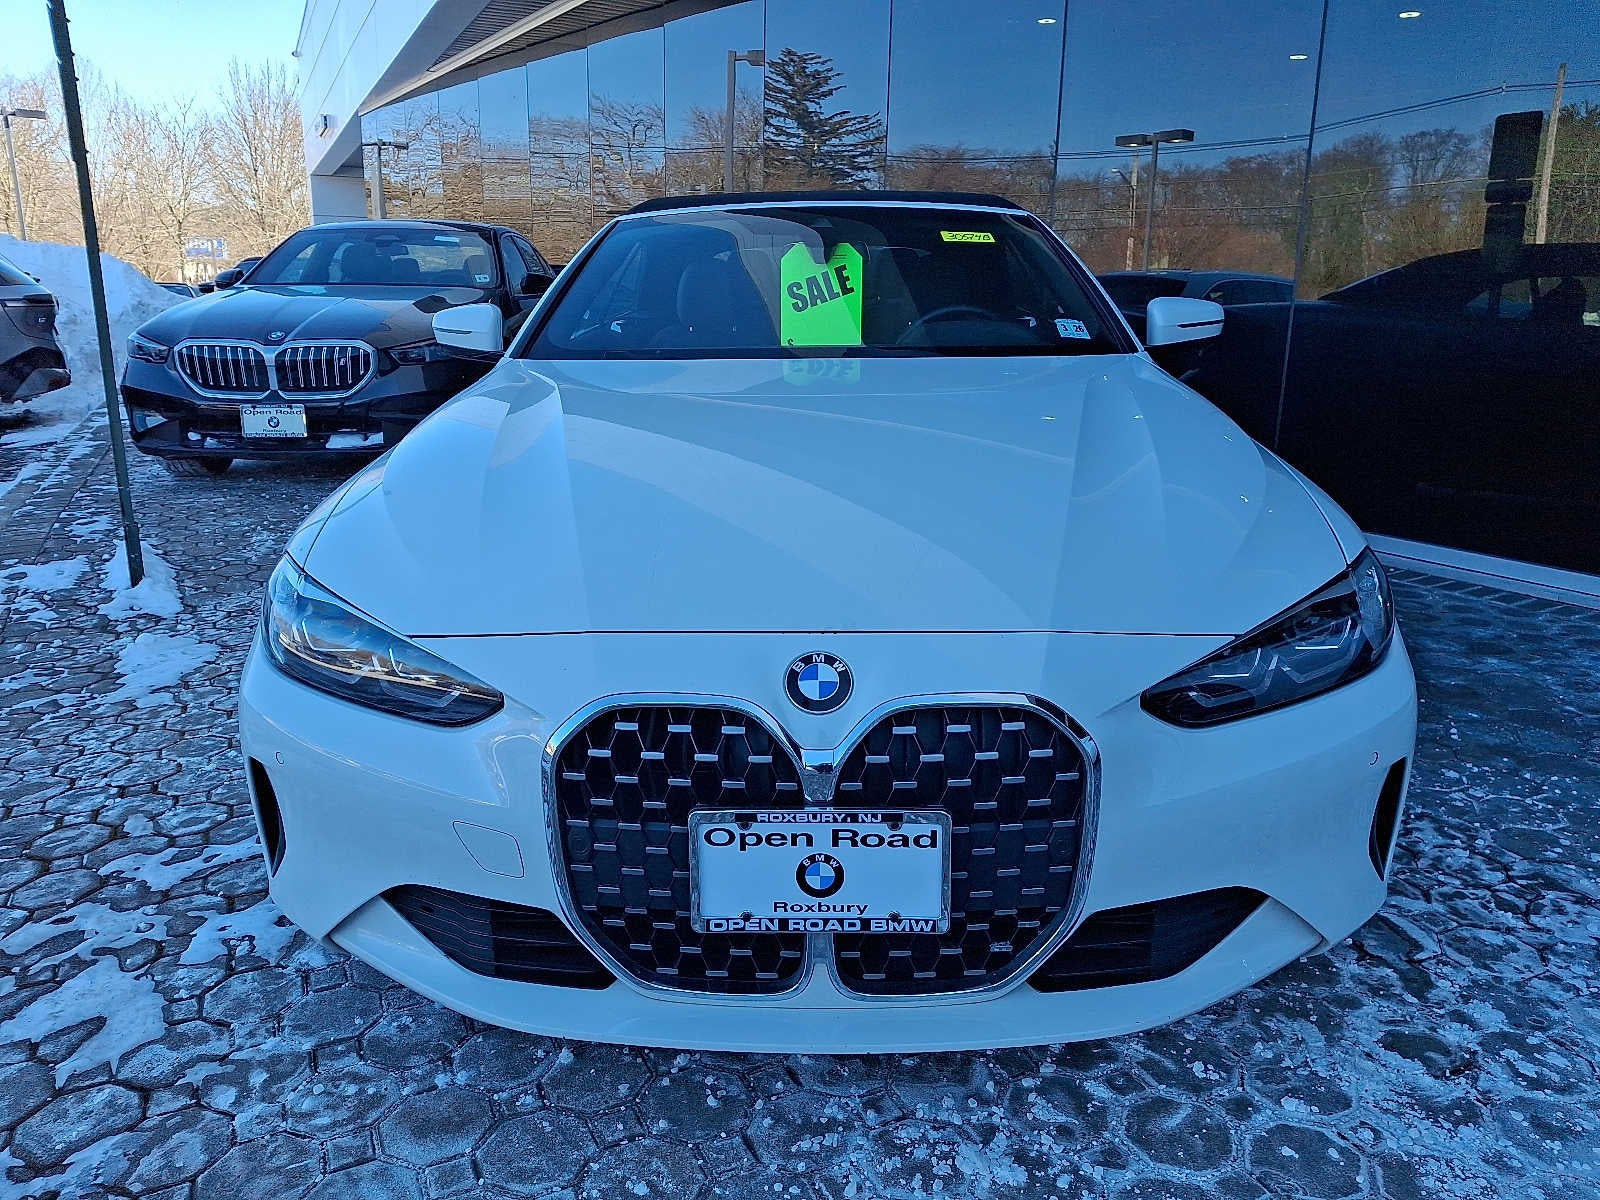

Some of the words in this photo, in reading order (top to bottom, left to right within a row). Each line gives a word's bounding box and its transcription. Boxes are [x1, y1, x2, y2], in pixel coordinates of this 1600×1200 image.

[786, 264, 855, 313] SALE
[243, 408, 272, 416] Open
[792, 654, 846, 673] BMW
[858, 813, 882, 822] NJ
[703, 827, 814, 851] Open
[831, 828, 938, 849] Road
[802, 854, 840, 868] BMW
[773, 901, 869, 914] Roxbury
[709, 919, 779, 932] OPEN
[788, 919, 861, 931] ROAD
[870, 920, 934, 932] BMW
